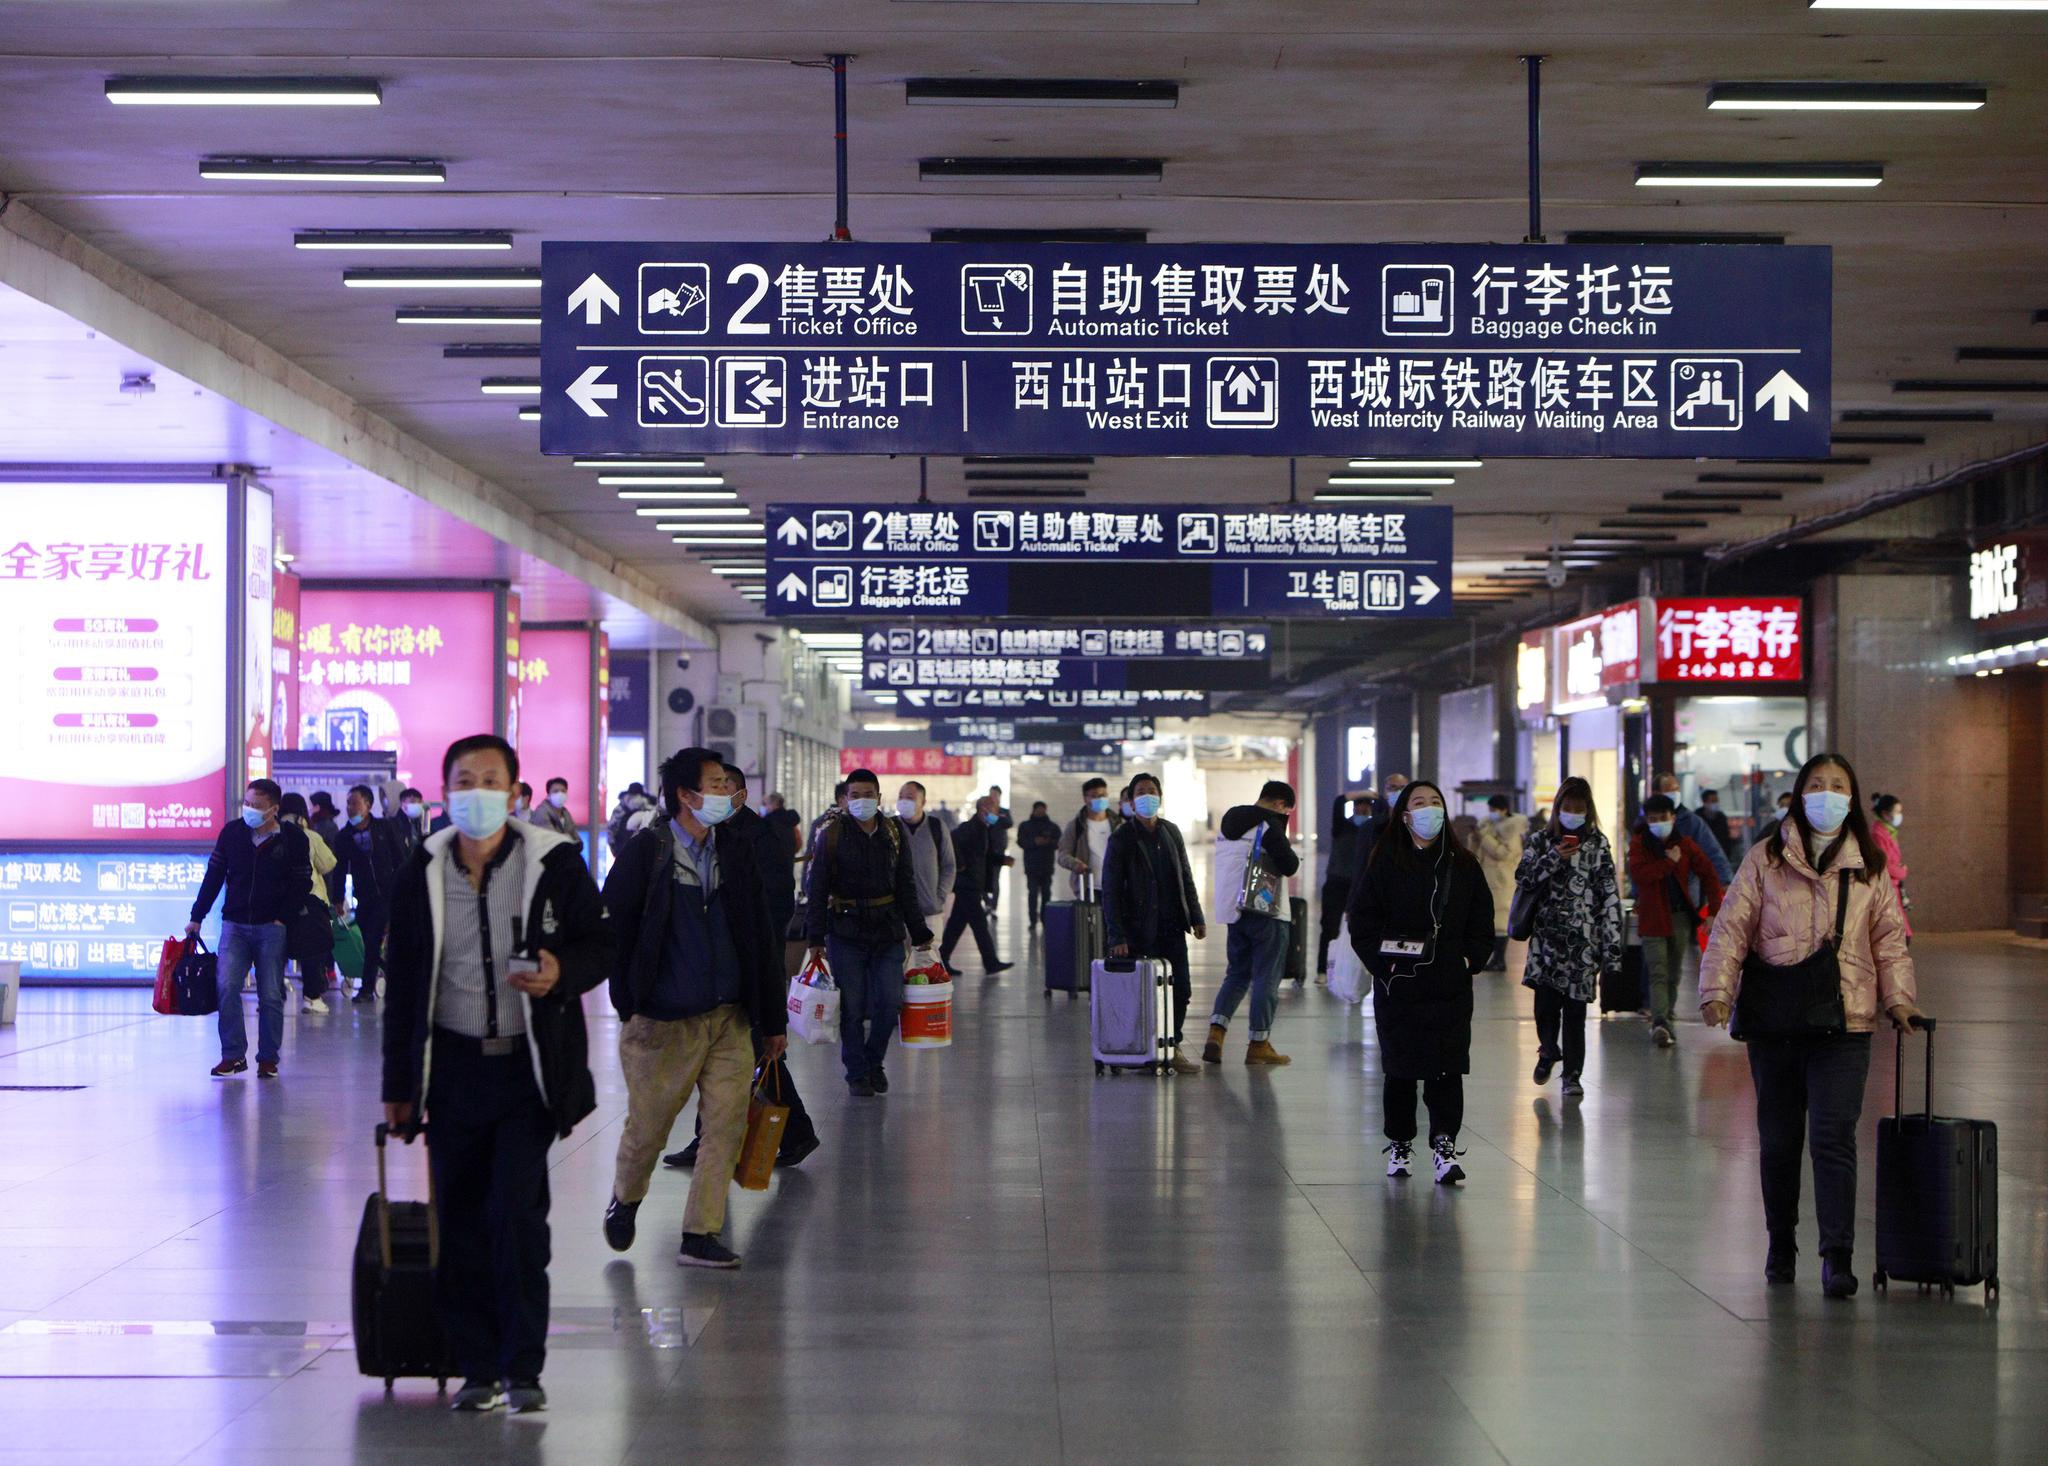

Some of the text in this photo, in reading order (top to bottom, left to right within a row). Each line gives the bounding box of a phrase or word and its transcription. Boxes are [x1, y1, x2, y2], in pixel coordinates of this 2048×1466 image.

[726, 263, 914, 335] 2售票处
[1052, 262, 1351, 316] 自助售取票处
[1472, 262, 1674, 317] 行李托运
[778, 317, 918, 335] Ticket Office
[1048, 317, 1229, 336] Automatic Ticket
[1471, 317, 1657, 339] Baggage Check in
[800, 356, 934, 410] 进站口
[1012, 358, 1192, 410] 西出站口
[1307, 357, 1659, 411] 西城际铁路候车区
[803, 411, 900, 429] Entrance
[1086, 410, 1189, 429] West Exit
[1311, 409, 1658, 433] West Intercity Railway Waiting Area
[862, 510, 960, 551] 2售票处
[1019, 511, 1164, 543] 自助售取票处
[1223, 512, 1406, 543] 西城际铁路候车区
[886, 540, 959, 552] Ticket Office
[1020, 541, 1120, 553] Automatic Ticket
[1225, 542, 1407, 556] West Intercity Railway Waiting Area
[0, 542, 210, 582] 全家享好礼
[860, 565, 970, 596] 行李托运
[1286, 570, 1360, 600] 卫生间
[860, 594, 961, 608] Baggage Check in
[1325, 599, 1359, 611] Toilet
[1659, 606, 1798, 659] 行李寄存
[128, 861, 205, 884] 行李托运
[39, 902, 137, 924] 航海汽车站
[87, 942, 145, 963] 出租车
